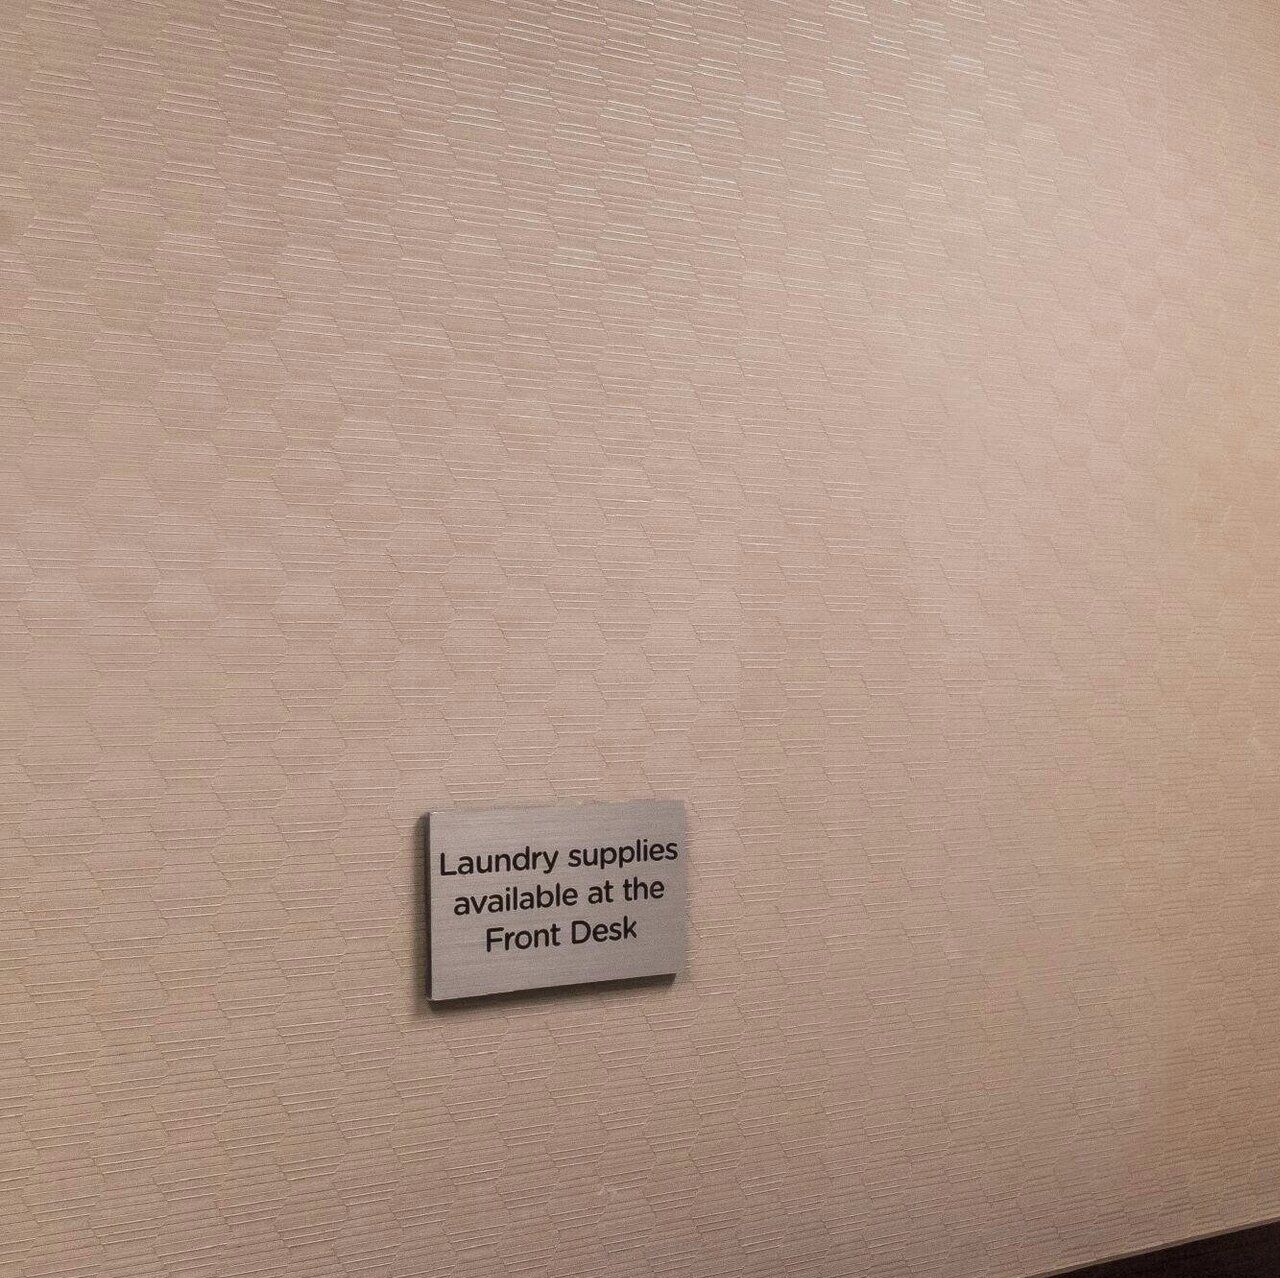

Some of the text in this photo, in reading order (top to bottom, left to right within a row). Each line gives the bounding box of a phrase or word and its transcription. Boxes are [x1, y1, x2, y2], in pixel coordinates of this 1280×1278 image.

[441, 839, 678, 876] Laundry supplies
[454, 876, 664, 915] available at the
[487, 916, 637, 952] Front Desk
